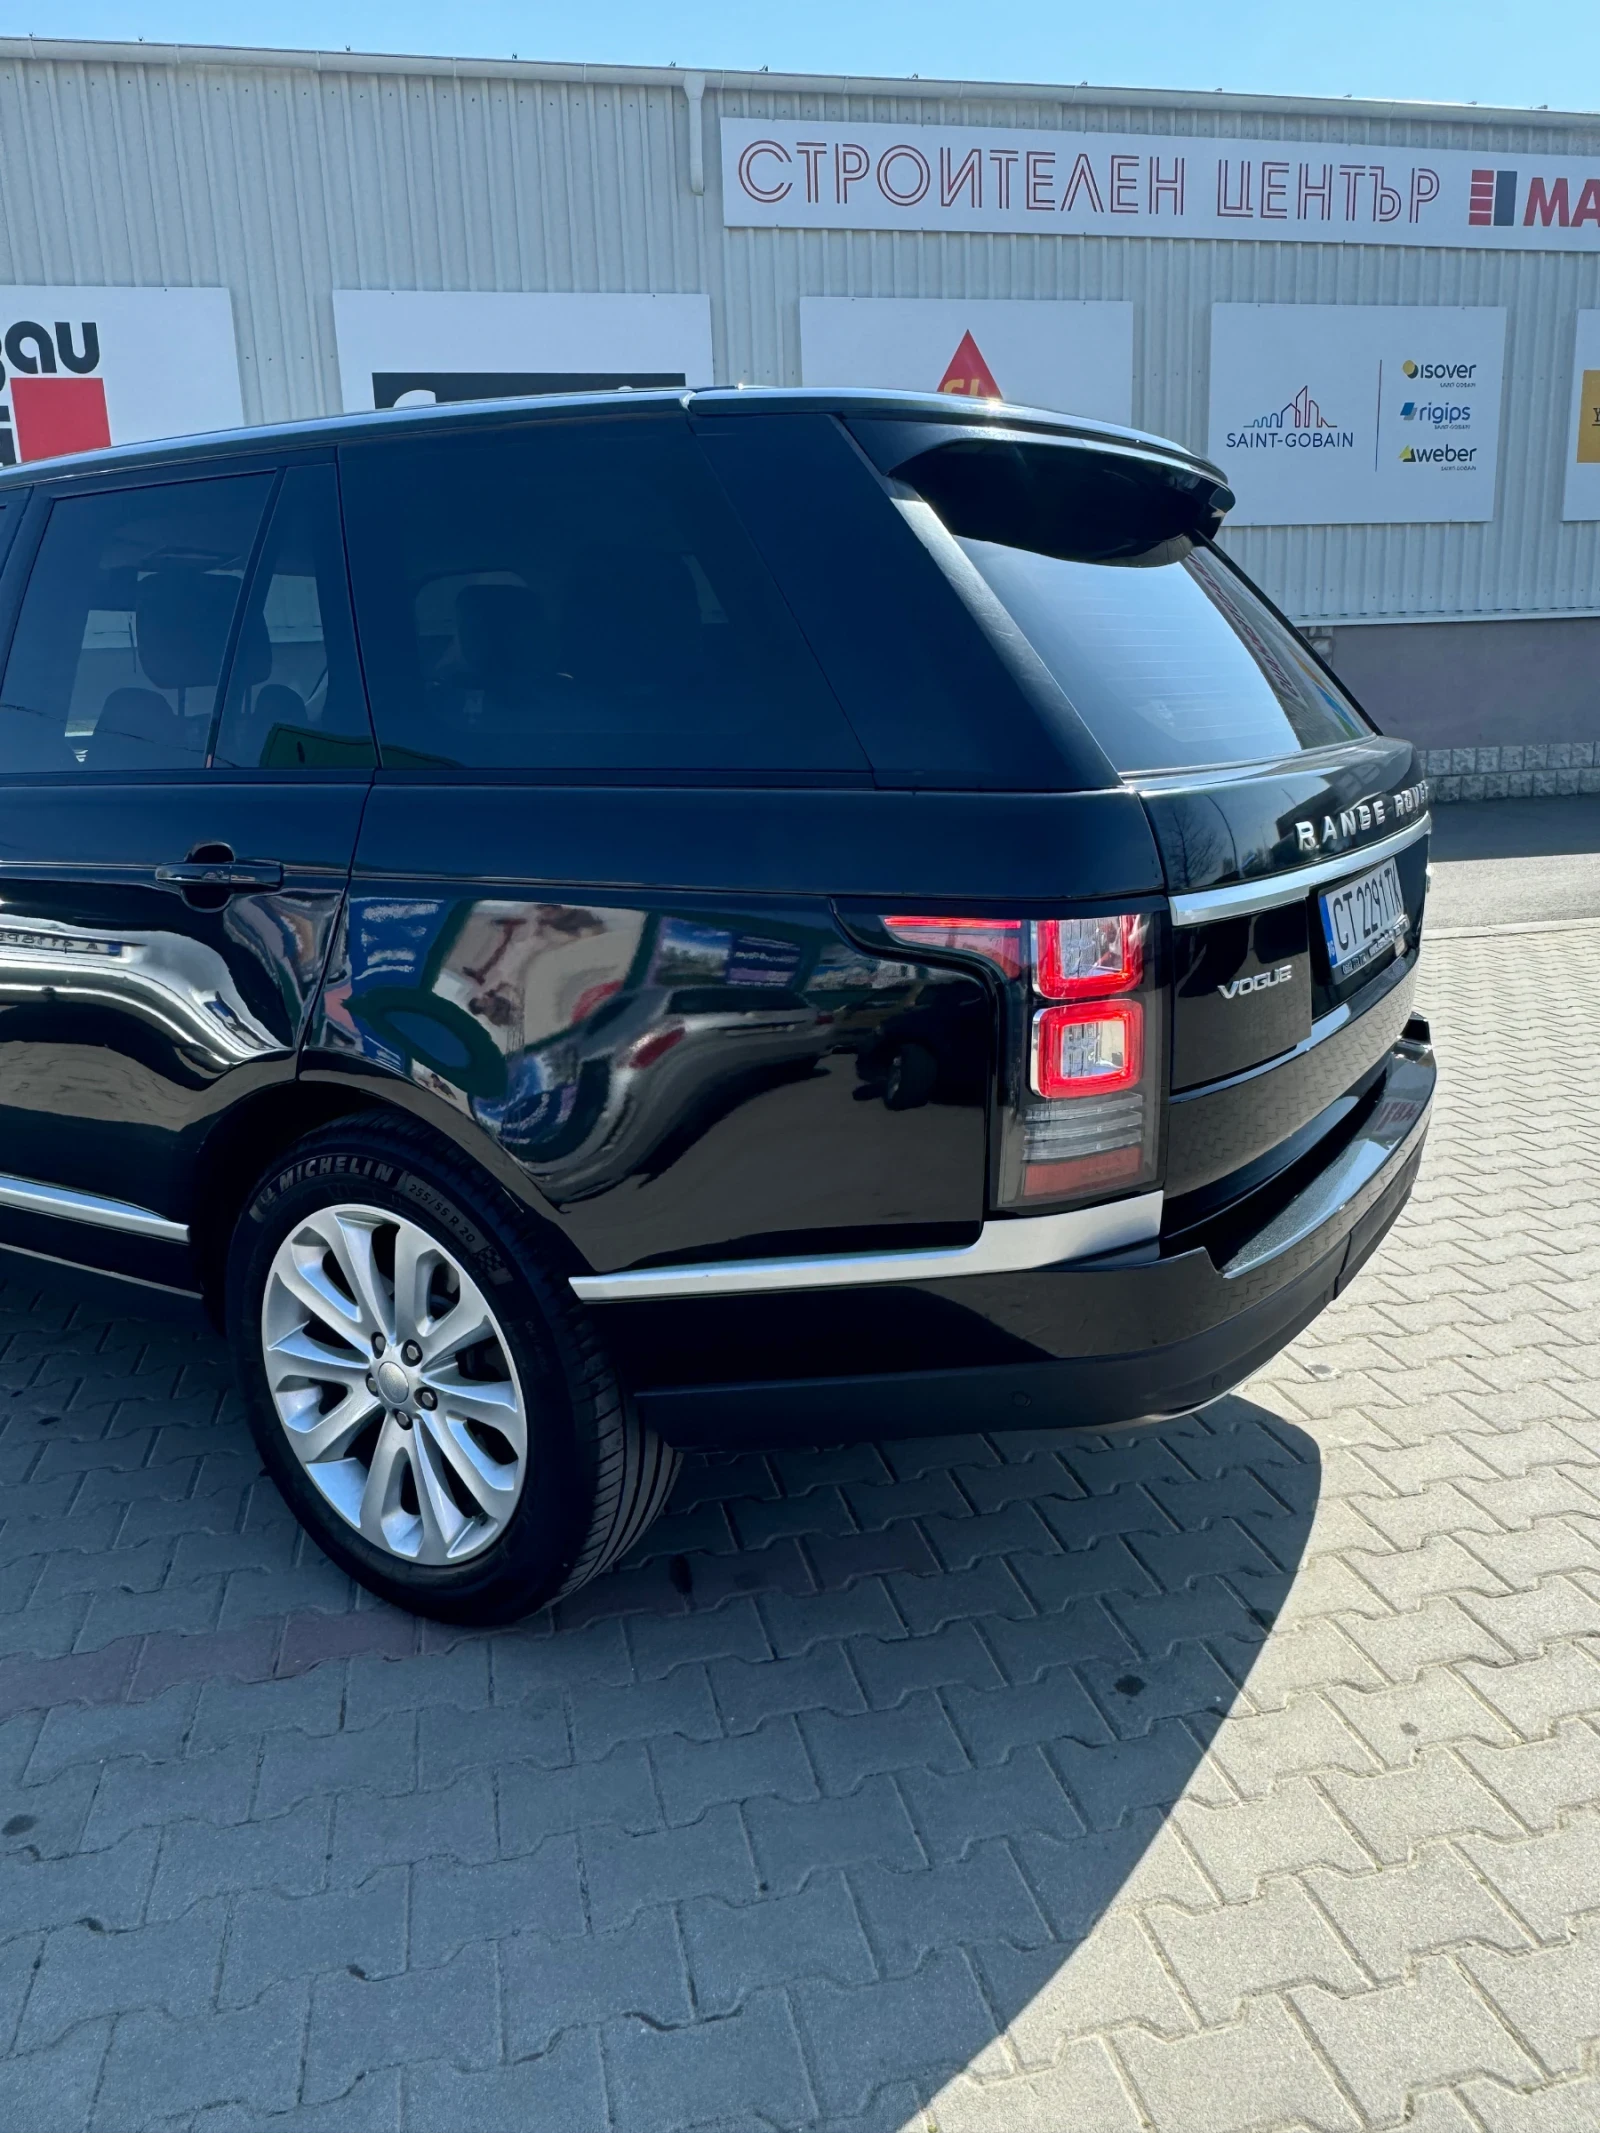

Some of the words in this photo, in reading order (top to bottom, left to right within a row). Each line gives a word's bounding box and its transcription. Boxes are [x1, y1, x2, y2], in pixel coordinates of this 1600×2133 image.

[738, 140, 1185, 216] СТРОИТЕЛЕН
[1216, 159, 1440, 223] ЦЕНТЪР
[0, 320, 100, 391] au
[1420, 364, 1477, 379] isover
[1419, 402, 1471, 424] rigips
[1226, 432, 1354, 448] SAINT-GOBAIN
[1416, 444, 1477, 462] weber
[1295, 800, 1386, 851] RANGE
[1333, 890, 1357, 951] CT
[1356, 872, 1390, 939] 2291
[1218, 964, 1293, 1000] VOGUE
[279, 1155, 394, 1193] MICHELIN
[409, 1184, 450, 1216] 255/55
[449, 1215, 460, 1227] R
[459, 1226, 475, 1243] 20
